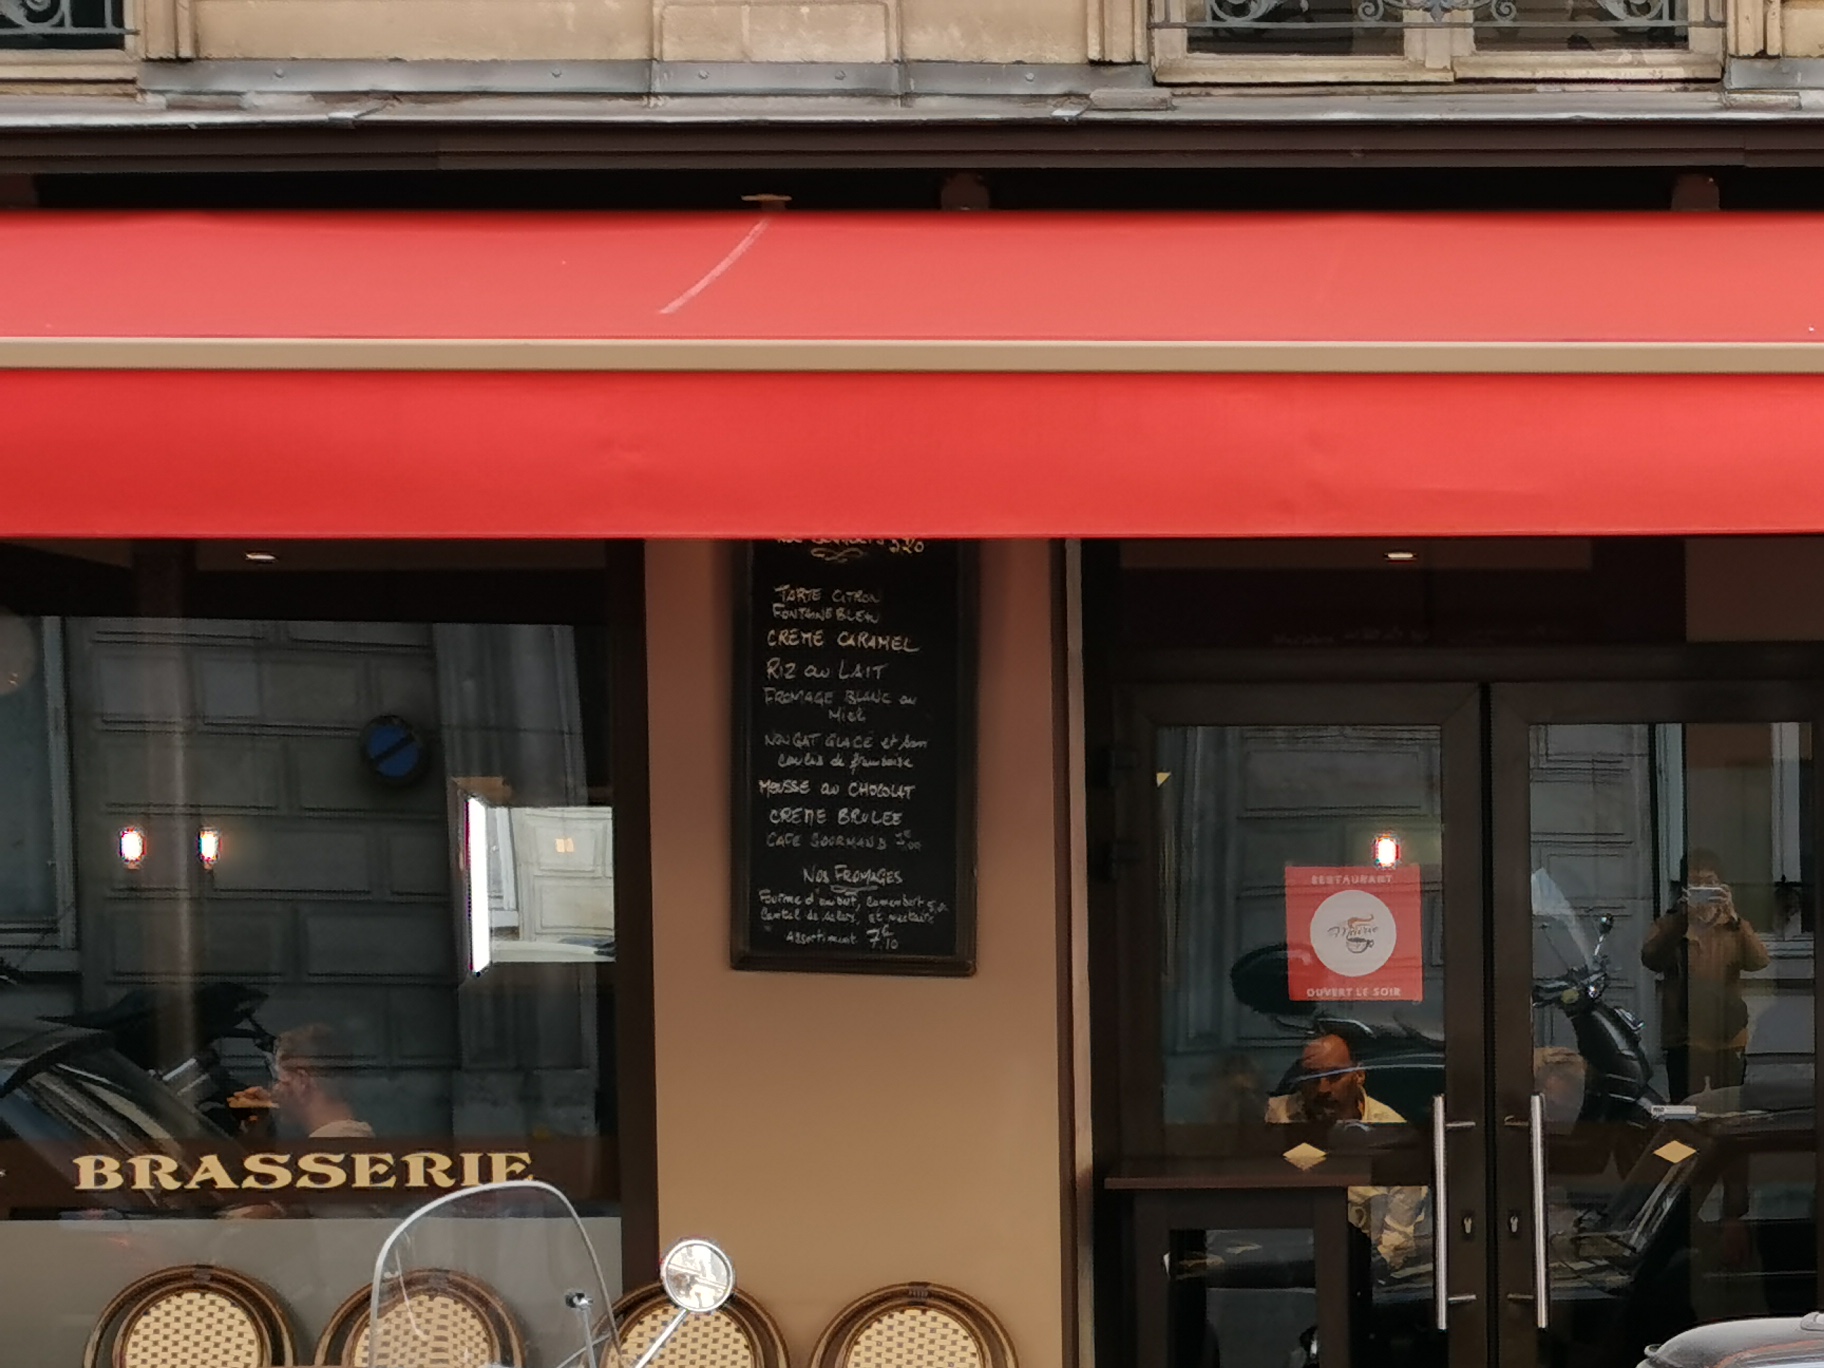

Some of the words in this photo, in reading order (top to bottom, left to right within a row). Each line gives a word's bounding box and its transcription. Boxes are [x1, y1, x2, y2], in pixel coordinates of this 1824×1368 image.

[837, 631, 920, 652] CARAMEL
[838, 659, 889, 680] LAIT
[1306, 987, 1353, 998] OUVERT
[1373, 987, 1402, 998] SOIR
[73, 1151, 535, 1191] BRASSERIE
